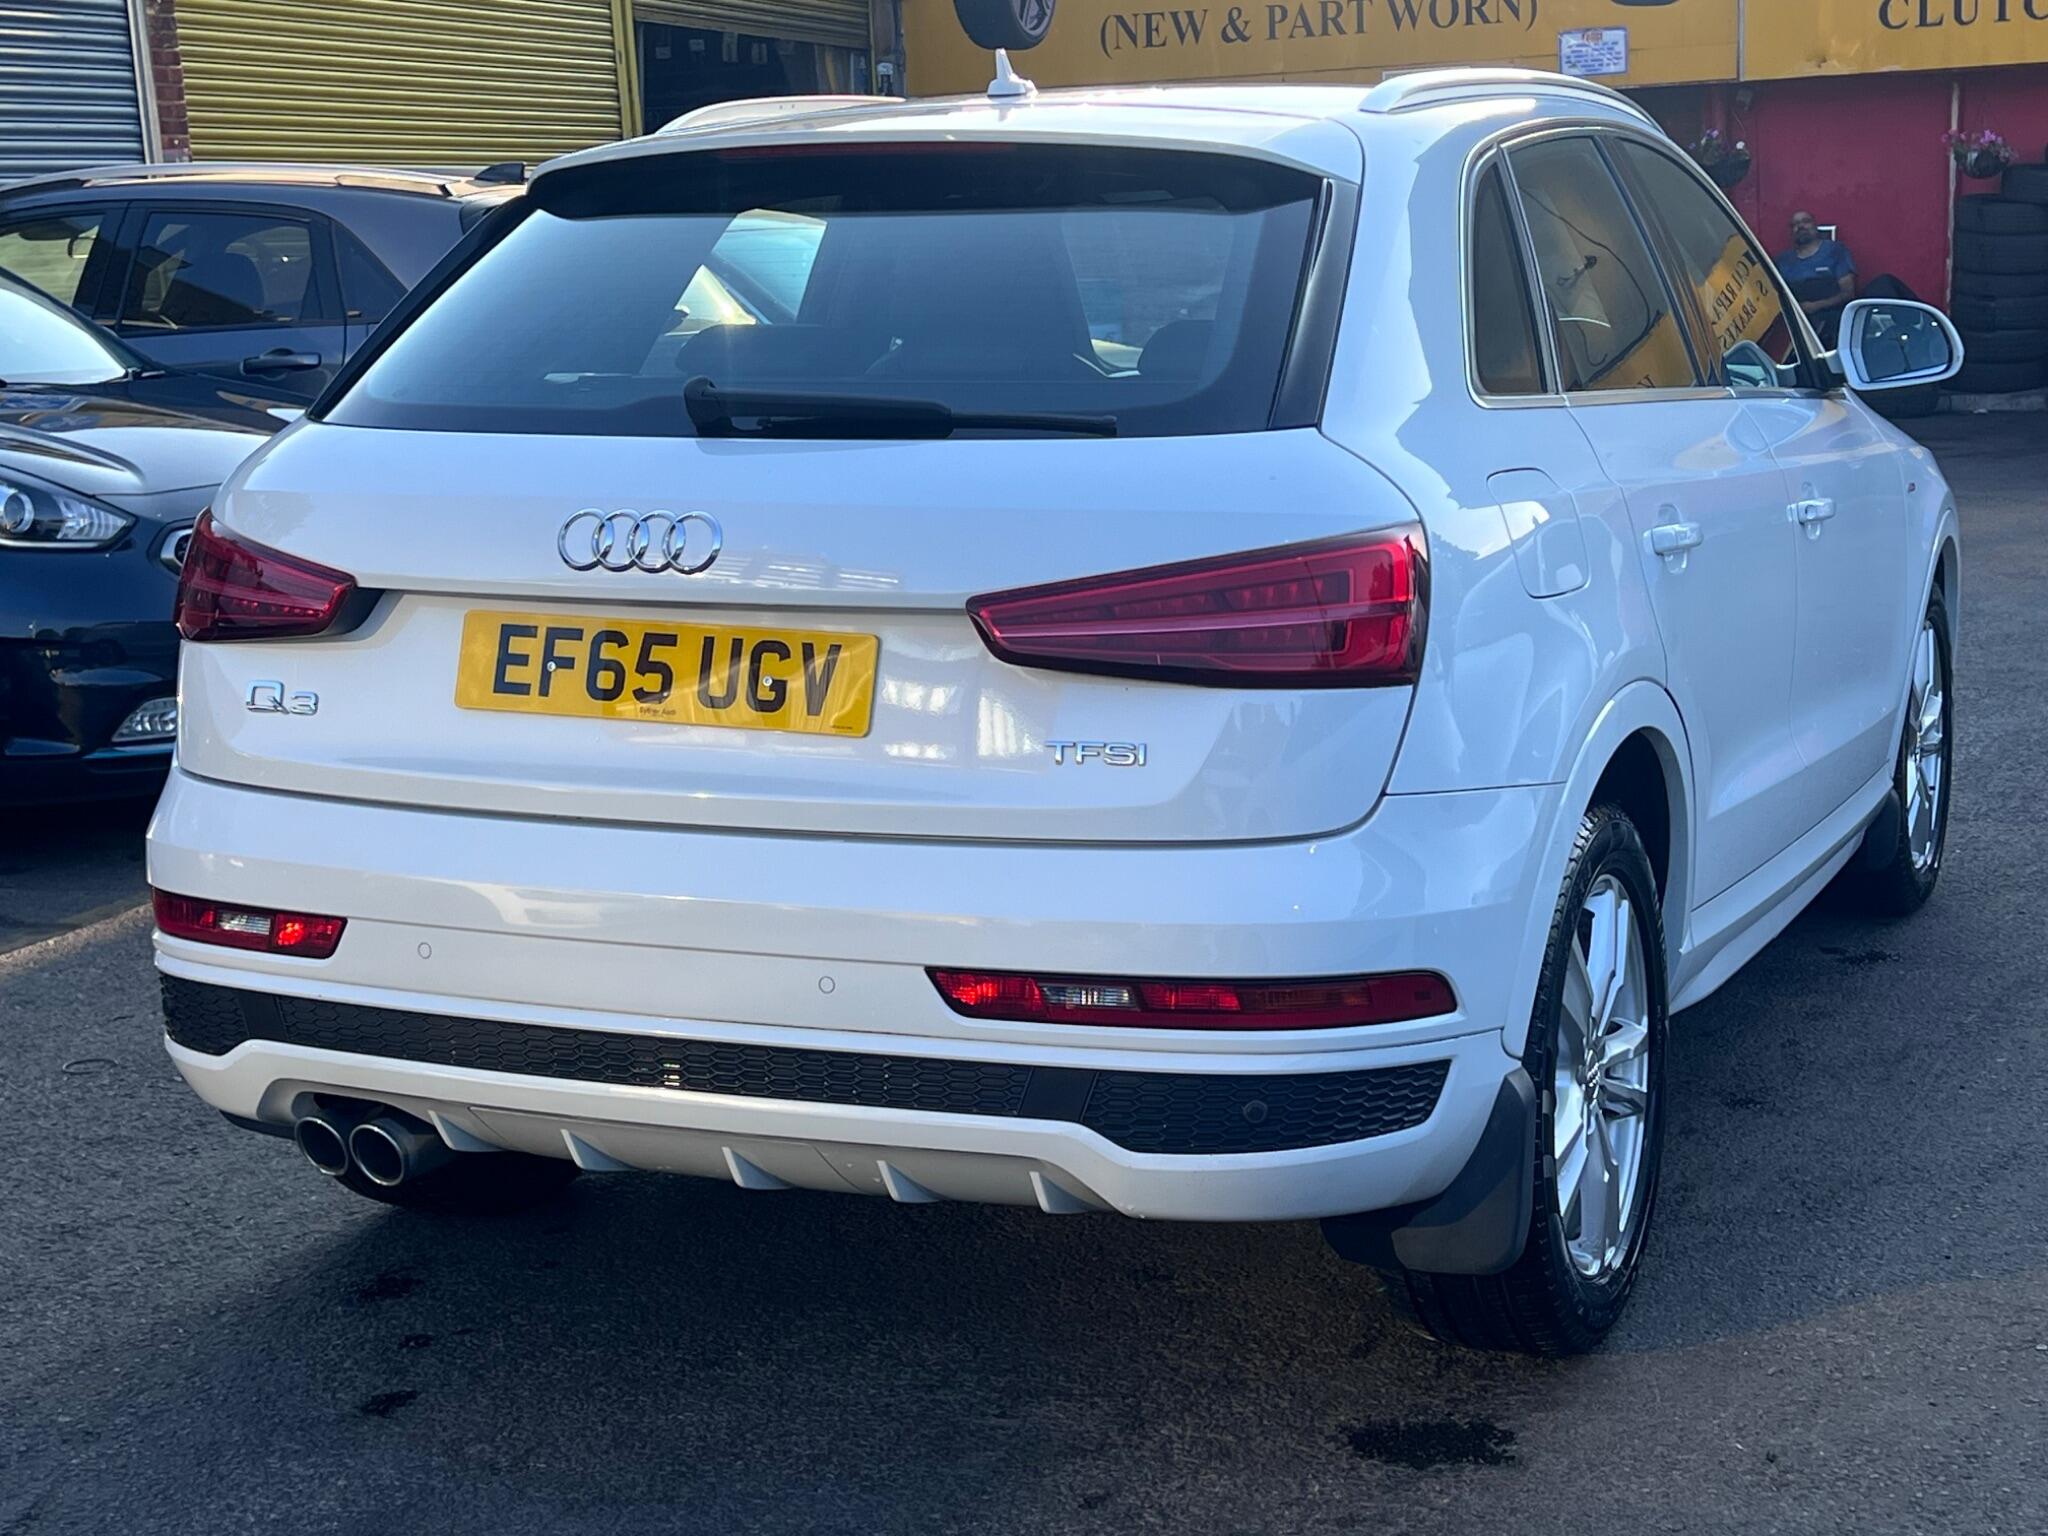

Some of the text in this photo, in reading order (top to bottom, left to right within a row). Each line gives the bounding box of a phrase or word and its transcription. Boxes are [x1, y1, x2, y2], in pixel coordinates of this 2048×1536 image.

[1100, 0, 1538, 60] (NEW & PART WORN)
[493, 623, 843, 717] EF65 UGV
[246, 679, 319, 716] Q3
[1045, 740, 1147, 767] TFSI
